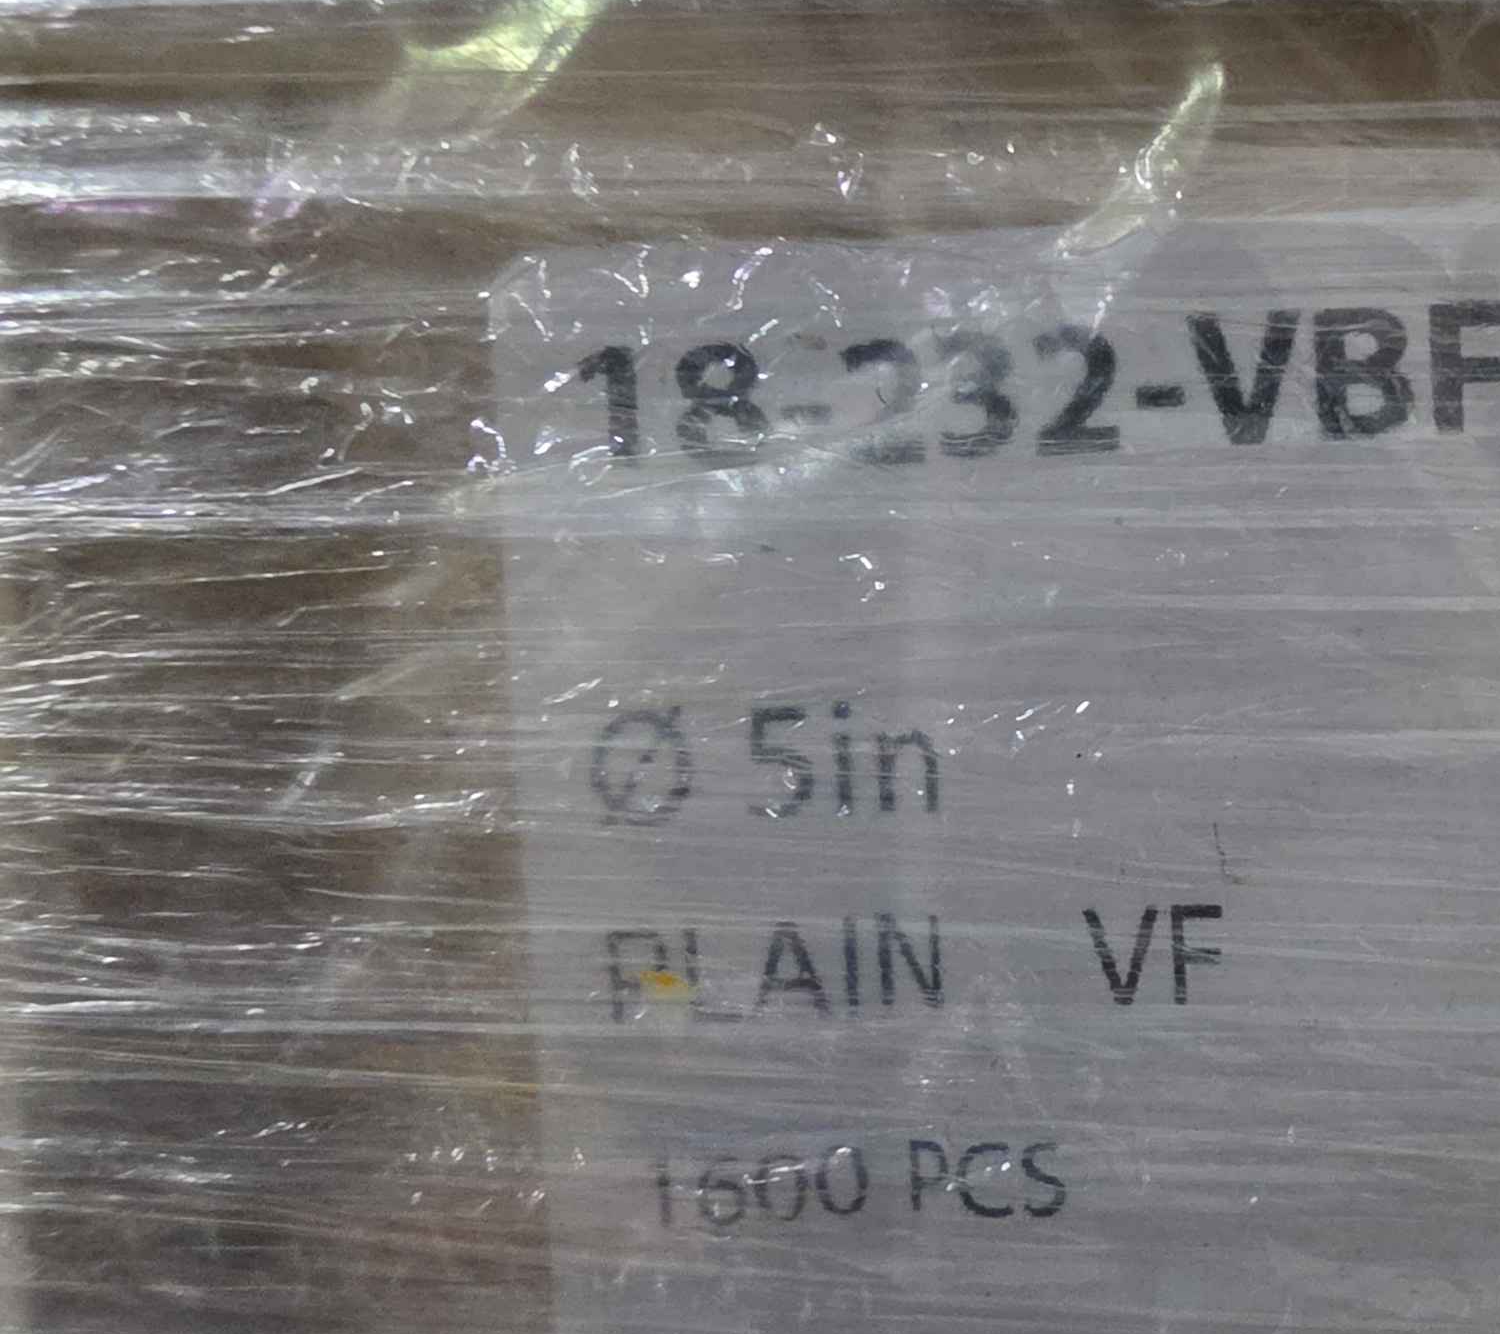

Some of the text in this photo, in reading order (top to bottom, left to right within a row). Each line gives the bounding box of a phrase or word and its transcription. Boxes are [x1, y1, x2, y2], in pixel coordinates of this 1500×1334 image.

[746, 700, 944, 820] 5in
[604, 903, 1224, 1024] PLAIN VF
[907, 1138, 1068, 1220] PCS
